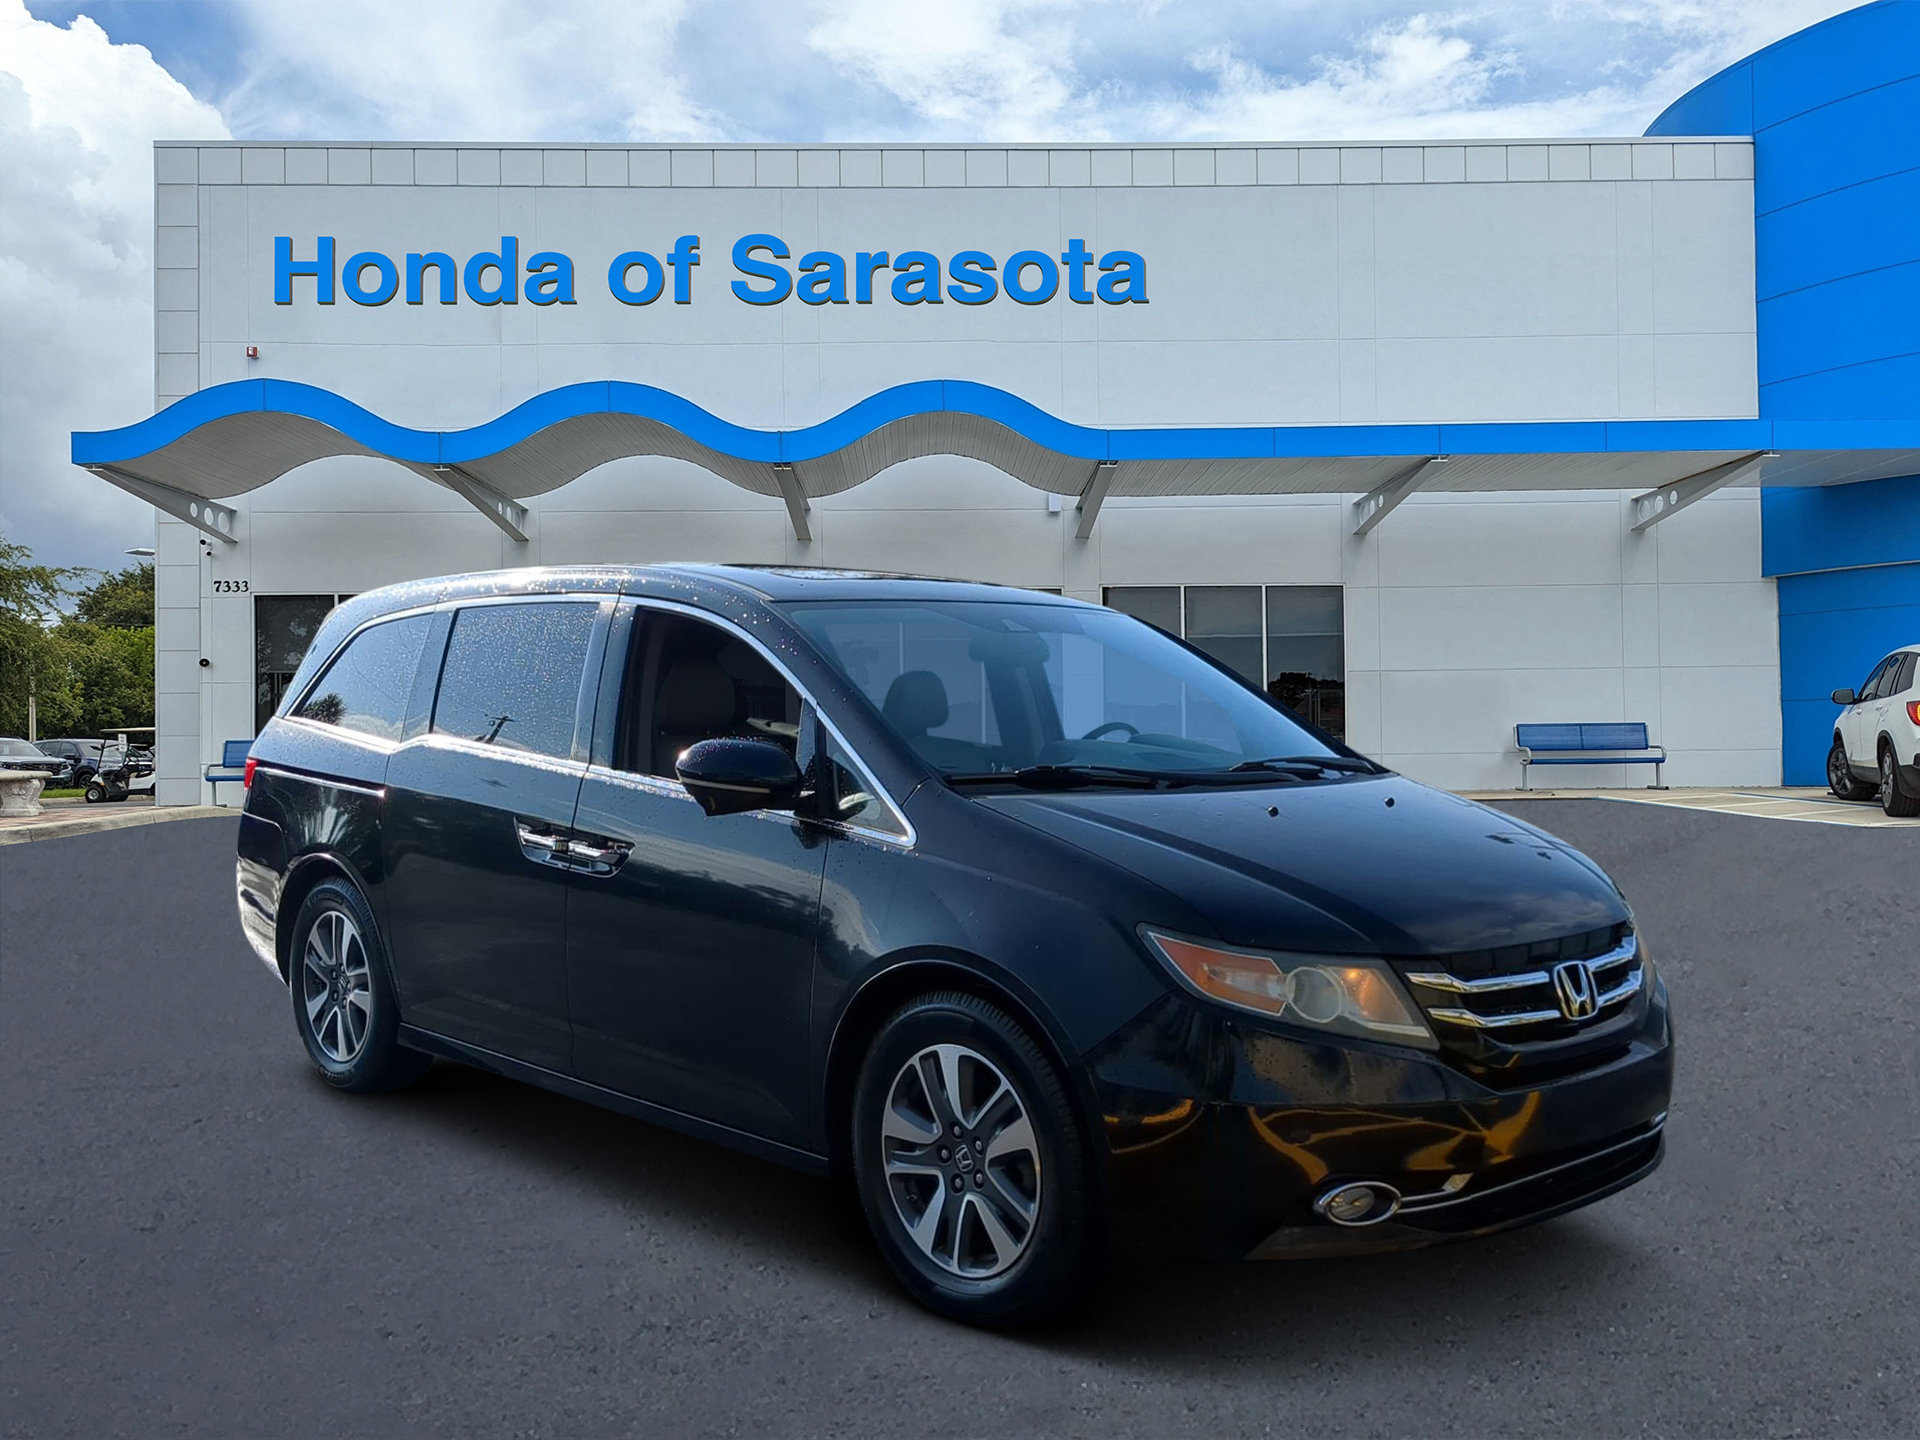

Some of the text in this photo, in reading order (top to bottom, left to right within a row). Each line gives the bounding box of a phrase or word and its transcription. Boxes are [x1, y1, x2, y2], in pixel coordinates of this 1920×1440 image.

[274, 234, 1149, 306] Honda of Sarasota
[213, 580, 249, 593] 7333
